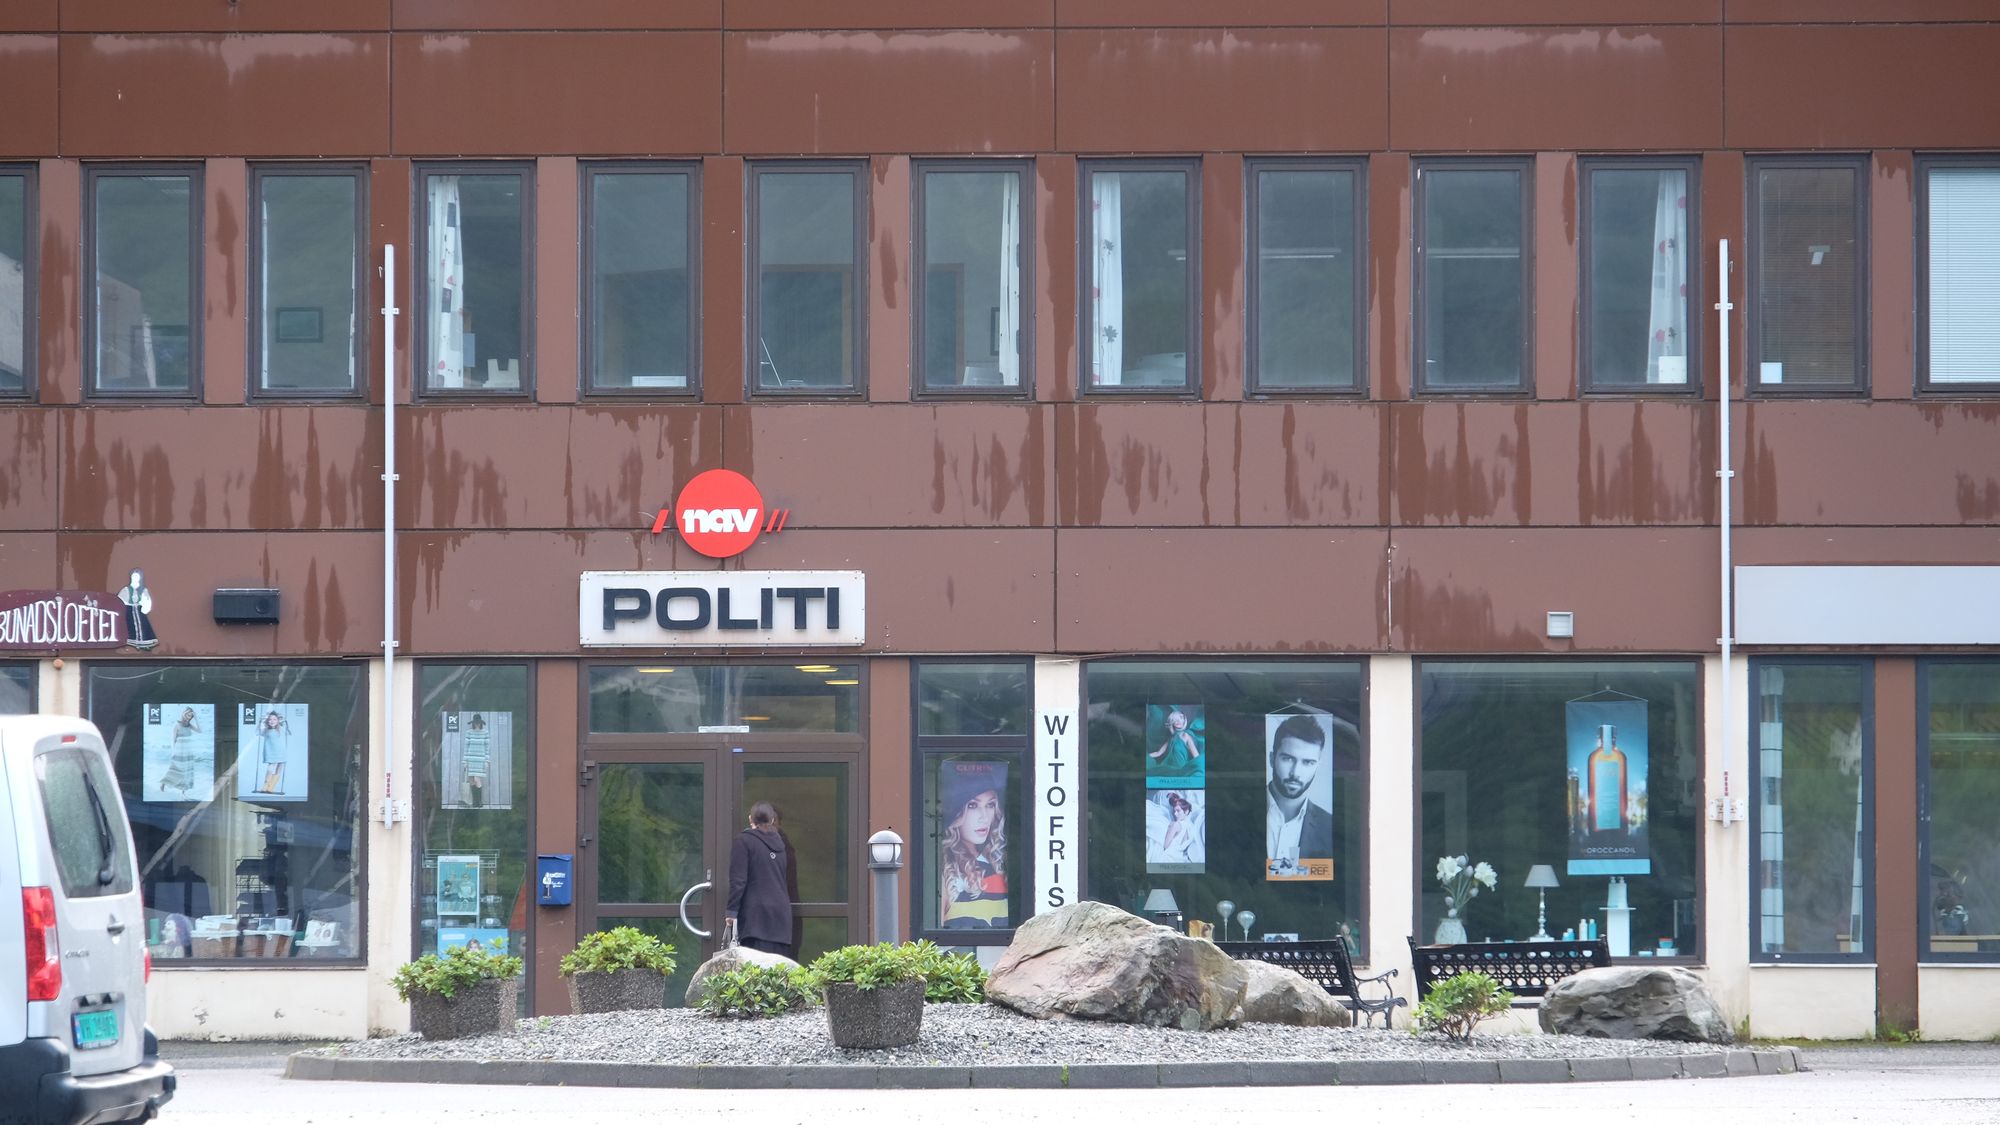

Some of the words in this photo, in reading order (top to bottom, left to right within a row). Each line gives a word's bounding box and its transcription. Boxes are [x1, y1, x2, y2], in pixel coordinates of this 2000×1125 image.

[682, 508, 759, 533] nav
[0, 600, 119, 643] BUNADSLOFTET
[602, 587, 840, 630] POLITI
